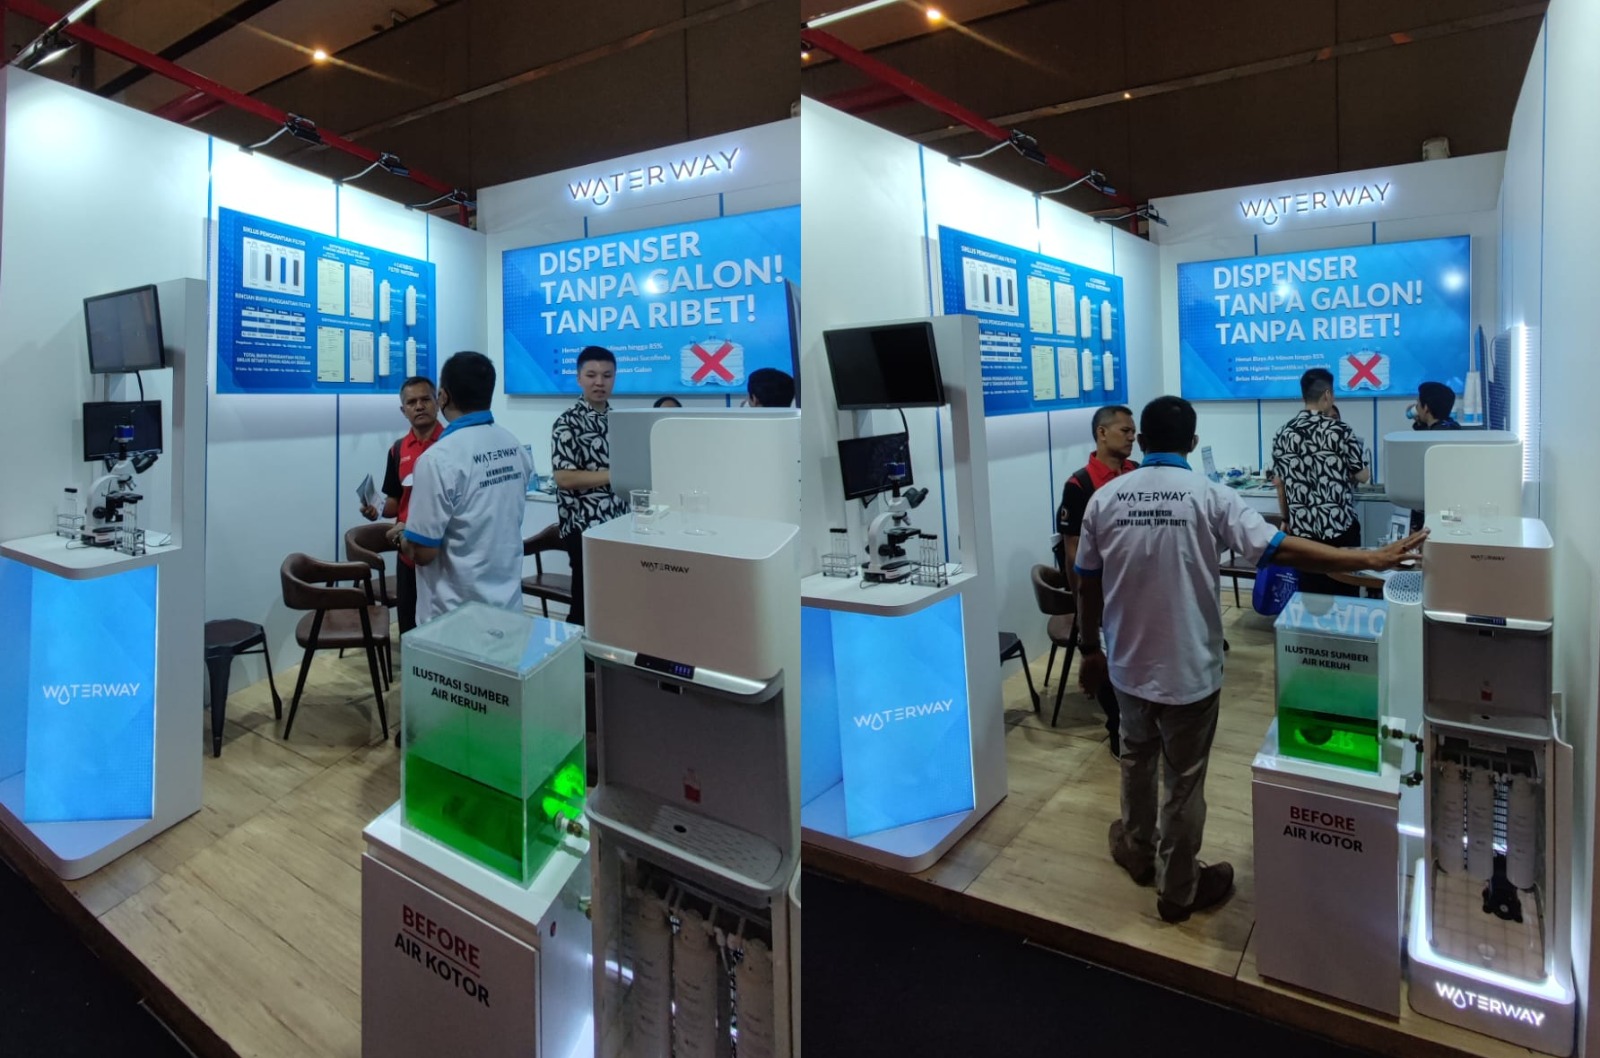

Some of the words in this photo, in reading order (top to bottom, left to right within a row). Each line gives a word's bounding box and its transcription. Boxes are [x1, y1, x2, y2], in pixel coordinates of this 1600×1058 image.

[568, 147, 740, 206] WATERWAY
[1239, 182, 1390, 225] WATERWAY
[539, 230, 702, 276] DISPENSER
[541, 271, 640, 305] TANPA
[648, 254, 784, 296] GALON!
[1213, 255, 1358, 290] DISPENSER
[541, 304, 641, 335] TANPA
[648, 294, 756, 328] RIBET!
[1215, 290, 1306, 317] TANPA
[1311, 280, 1423, 310] GALON!
[1215, 319, 1306, 345] TANPA
[1312, 313, 1400, 341] RIBET!
[473, 447, 518, 468] WATERWAY
[1117, 491, 1187, 508] WATERWAY
[640, 560, 690, 573] WATERWAY
[1285, 645, 1329, 658] ILUSTRASI
[1330, 650, 1369, 662] SUMBER
[1302, 657, 1317, 666] AIR
[1318, 660, 1350, 670] KERUH
[43, 683, 140, 705] WATERWAY
[412, 666, 462, 690] ILUSTRASI
[464, 682, 510, 707] SUMBER
[431, 687, 448, 700] AIR
[450, 693, 486, 714] KERUH
[853, 699, 953, 731] WATERWAY
[1290, 806, 1356, 832] BEFORE
[1283, 825, 1307, 840] AIR
[1310, 830, 1363, 853] KOTOR
[403, 904, 480, 969] BEFORE
[394, 932, 422, 963] AIR
[426, 951, 490, 1008] KOTOR
[1435, 981, 1546, 1026] WATERWAY
